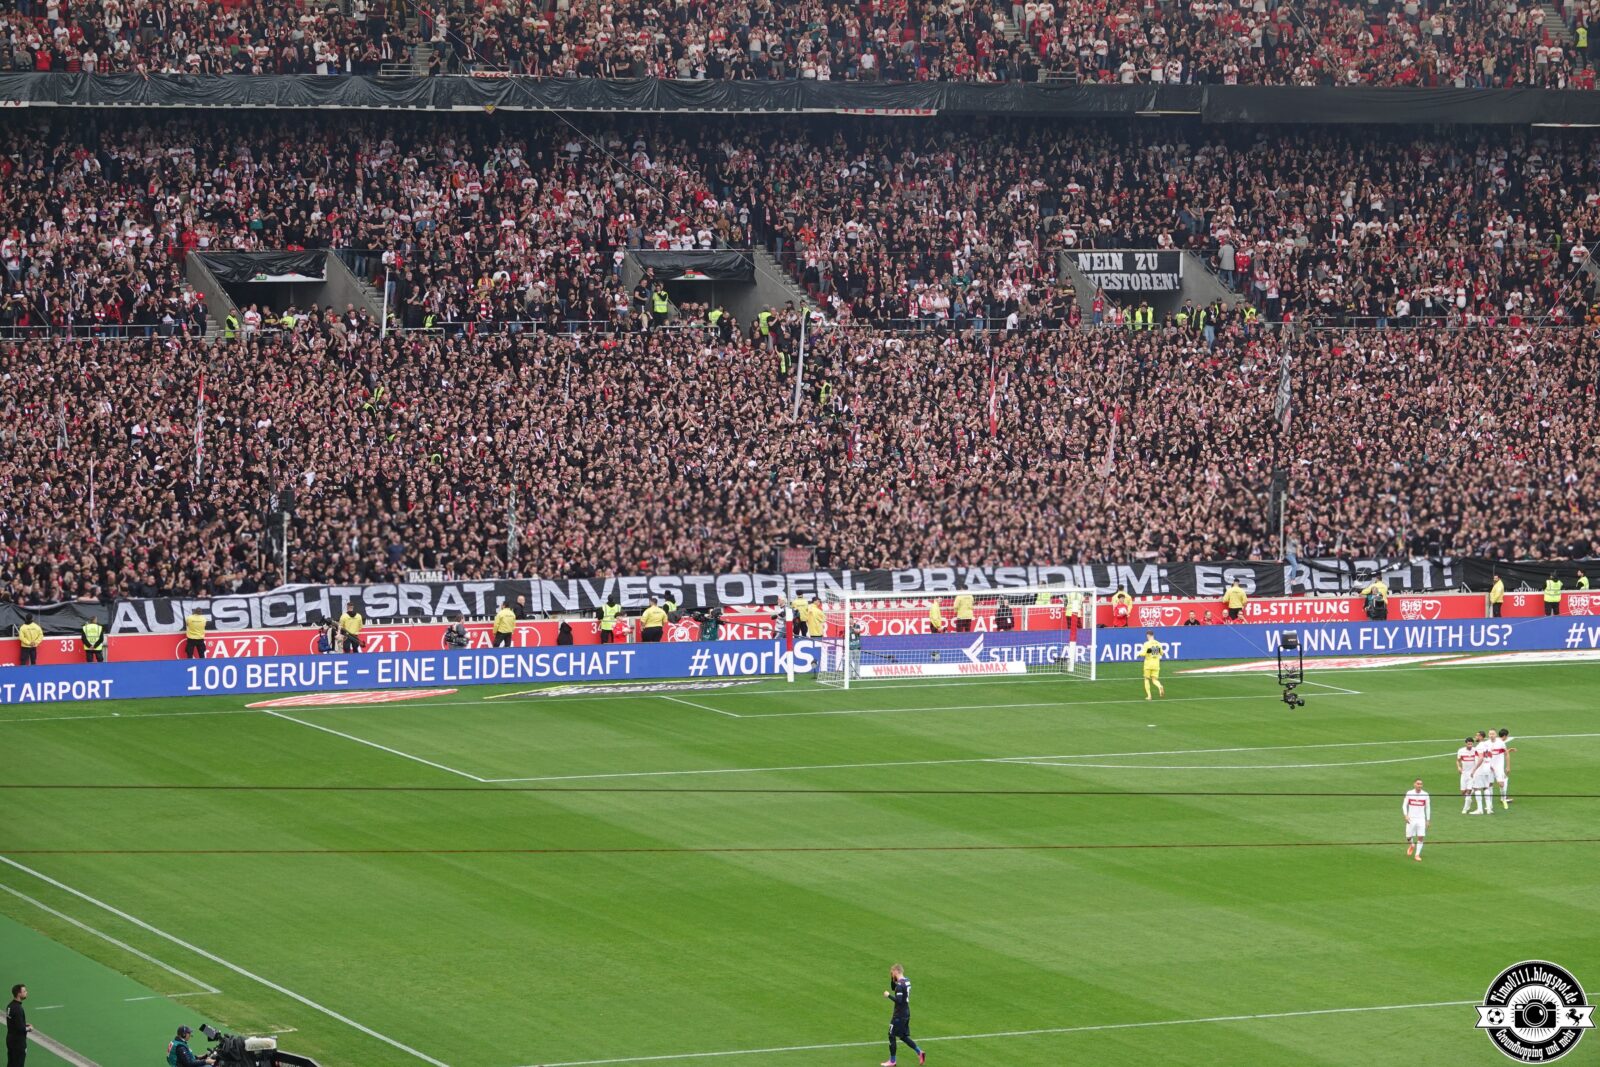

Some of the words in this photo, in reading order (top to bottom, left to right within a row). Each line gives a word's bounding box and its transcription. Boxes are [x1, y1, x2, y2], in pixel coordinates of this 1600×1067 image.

[1078, 252, 1124, 271] NEIN
[1134, 252, 1158, 271] ZU
[1195, 562, 1256, 595] ES
[1245, 600, 1350, 616] fB-STIFTUNG
[1513, 595, 1525, 607] 36
[1050, 608, 1062, 620] 35
[60, 640, 75, 652] 33
[1265, 628, 1353, 653] WNNA
[1360, 627, 1400, 650] FLY
[1404, 625, 1463, 649] WITH
[1470, 623, 1513, 647] US?
[1101, 642, 1181, 662] AIRPRT
[187, 665, 238, 691] 100
[246, 661, 349, 688] BERUFE
[377, 657, 436, 683] EINE
[443, 650, 636, 681] LEIDENSCHAFT
[873, 665, 924, 677] WINAMAX
[958, 663, 1009, 674] WINAMAX
[19, 679, 114, 703] AIRPORT
